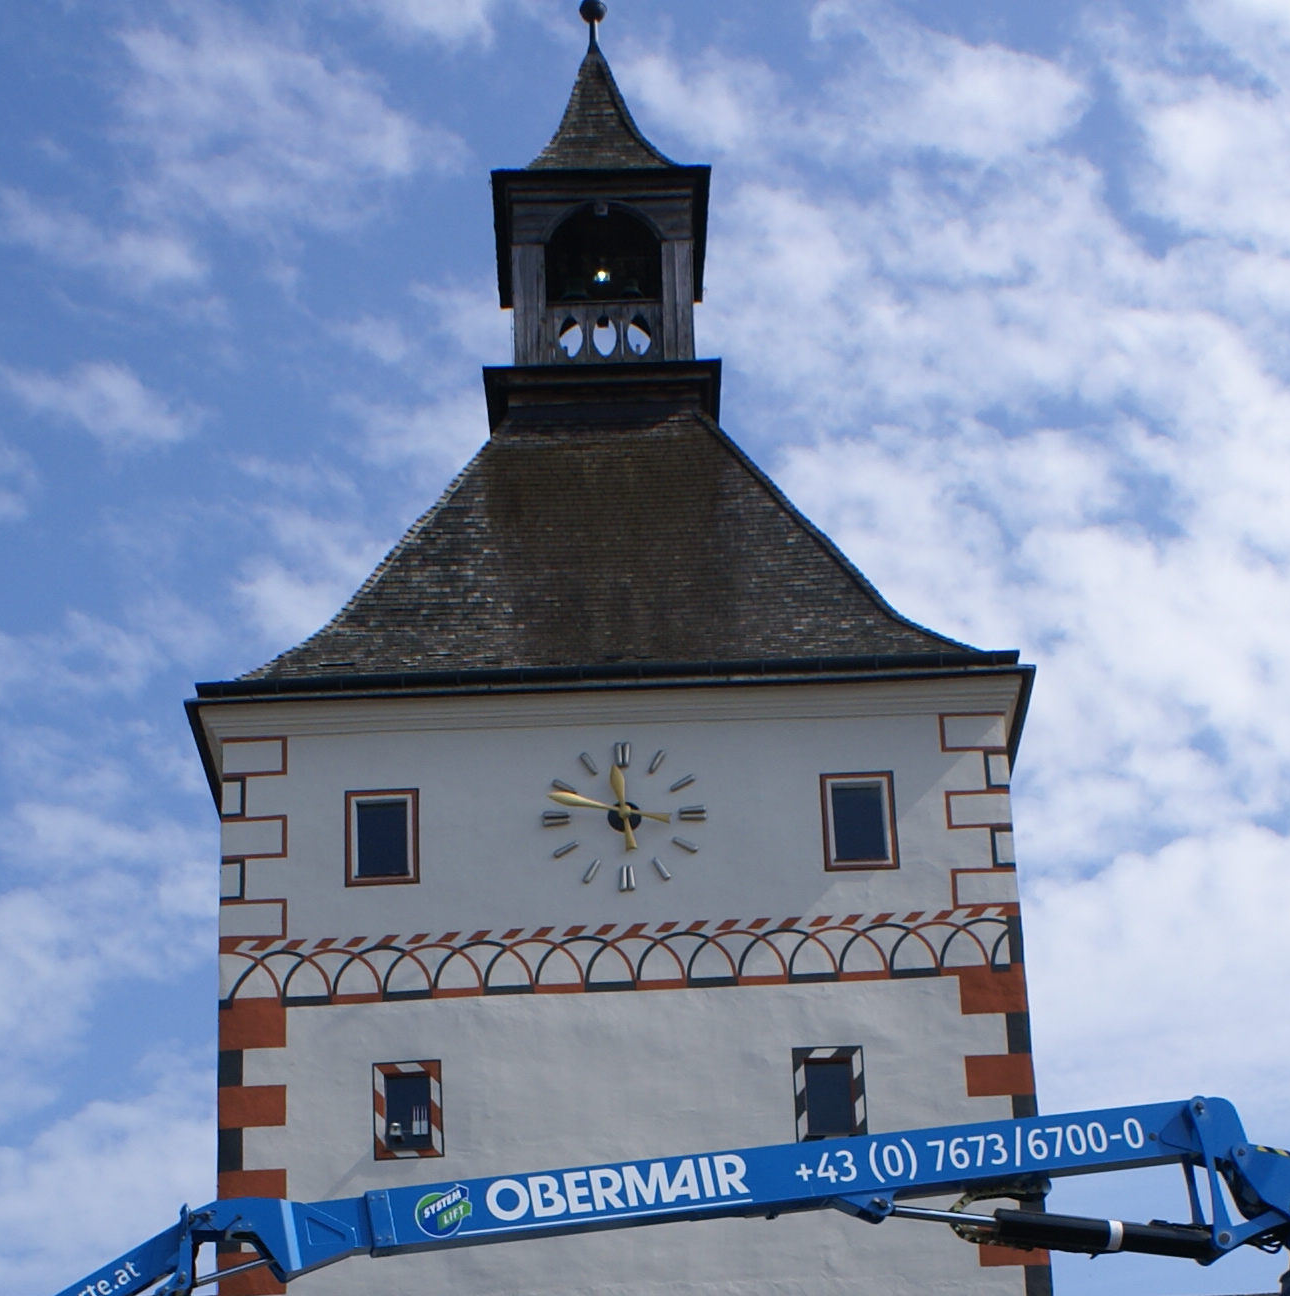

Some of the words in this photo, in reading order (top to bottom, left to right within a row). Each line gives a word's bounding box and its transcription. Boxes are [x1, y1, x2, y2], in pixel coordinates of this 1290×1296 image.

[795, 1150, 857, 1184] +43
[868, 1137, 917, 1184] (0)
[423, 1189, 462, 1219] SYSTEM
[485, 1154, 751, 1222] OBERMAIR
[443, 1204, 465, 1225] LIFT
